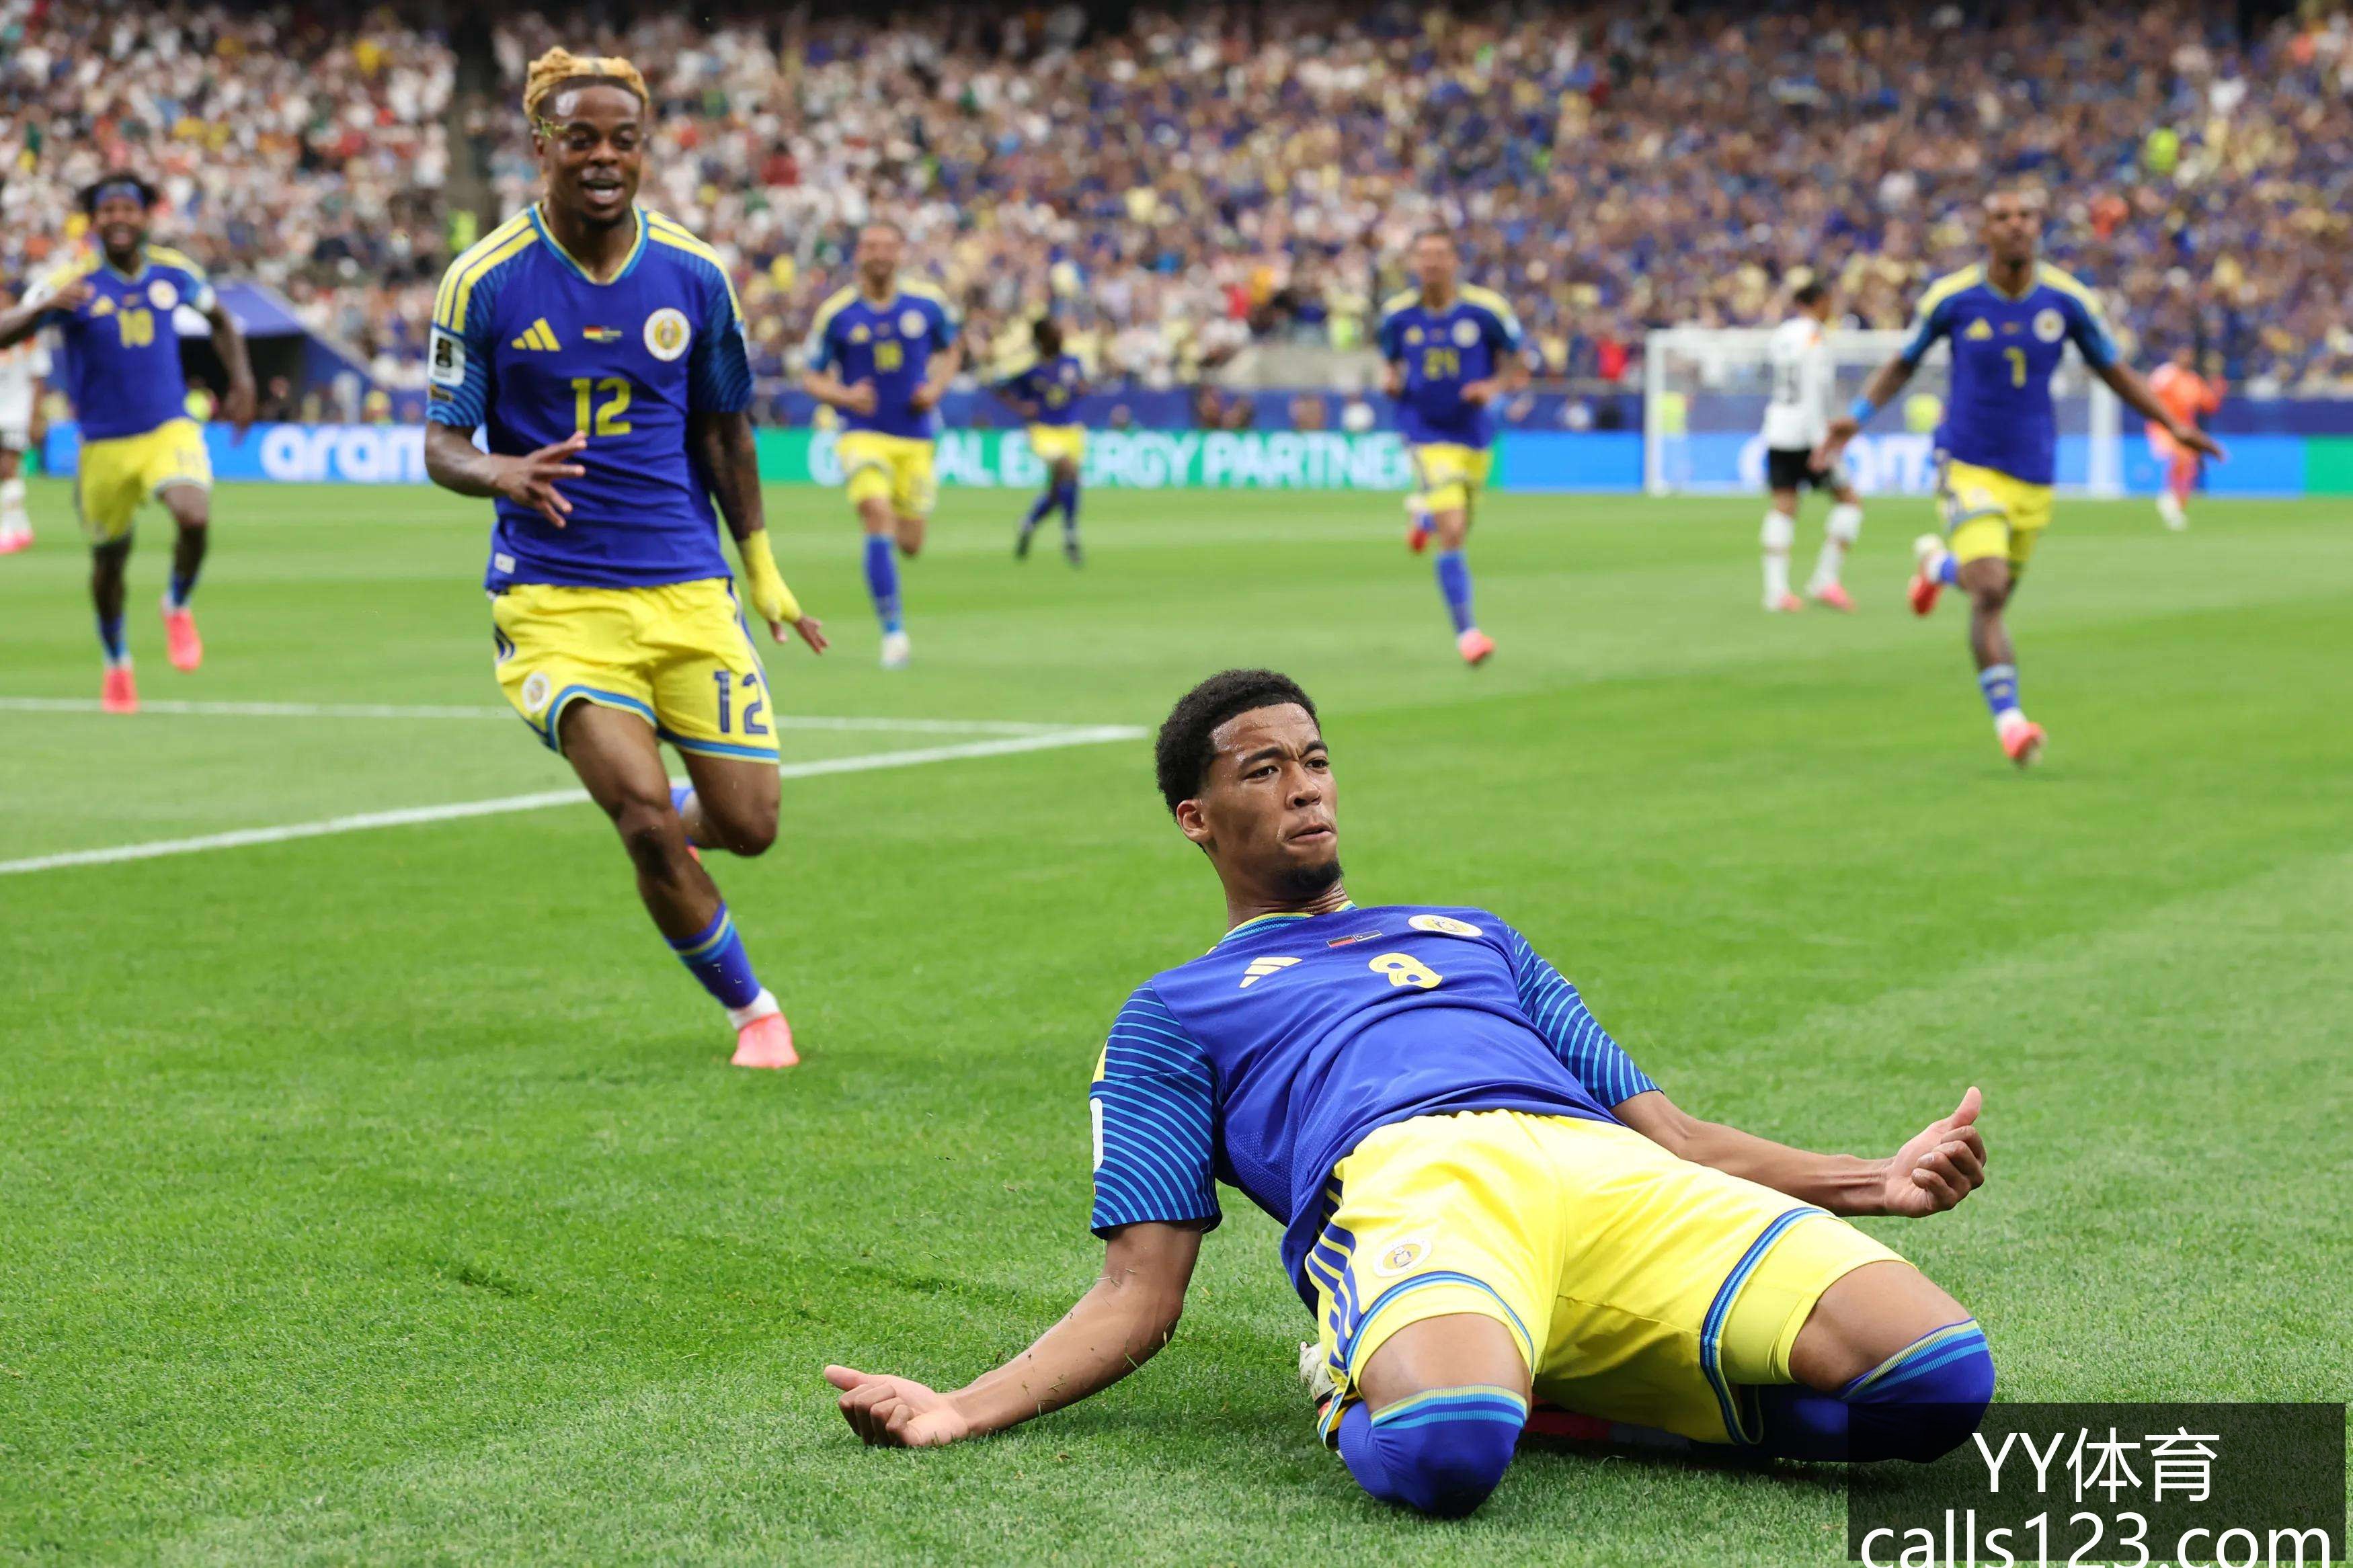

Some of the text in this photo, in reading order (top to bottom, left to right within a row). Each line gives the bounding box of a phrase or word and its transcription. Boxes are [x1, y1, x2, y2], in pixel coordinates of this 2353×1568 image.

[571, 377, 633, 436] 12
[1203, 430, 1413, 490] PARTNE
[714, 669, 768, 734] 12
[1368, 952, 1443, 989] 8
